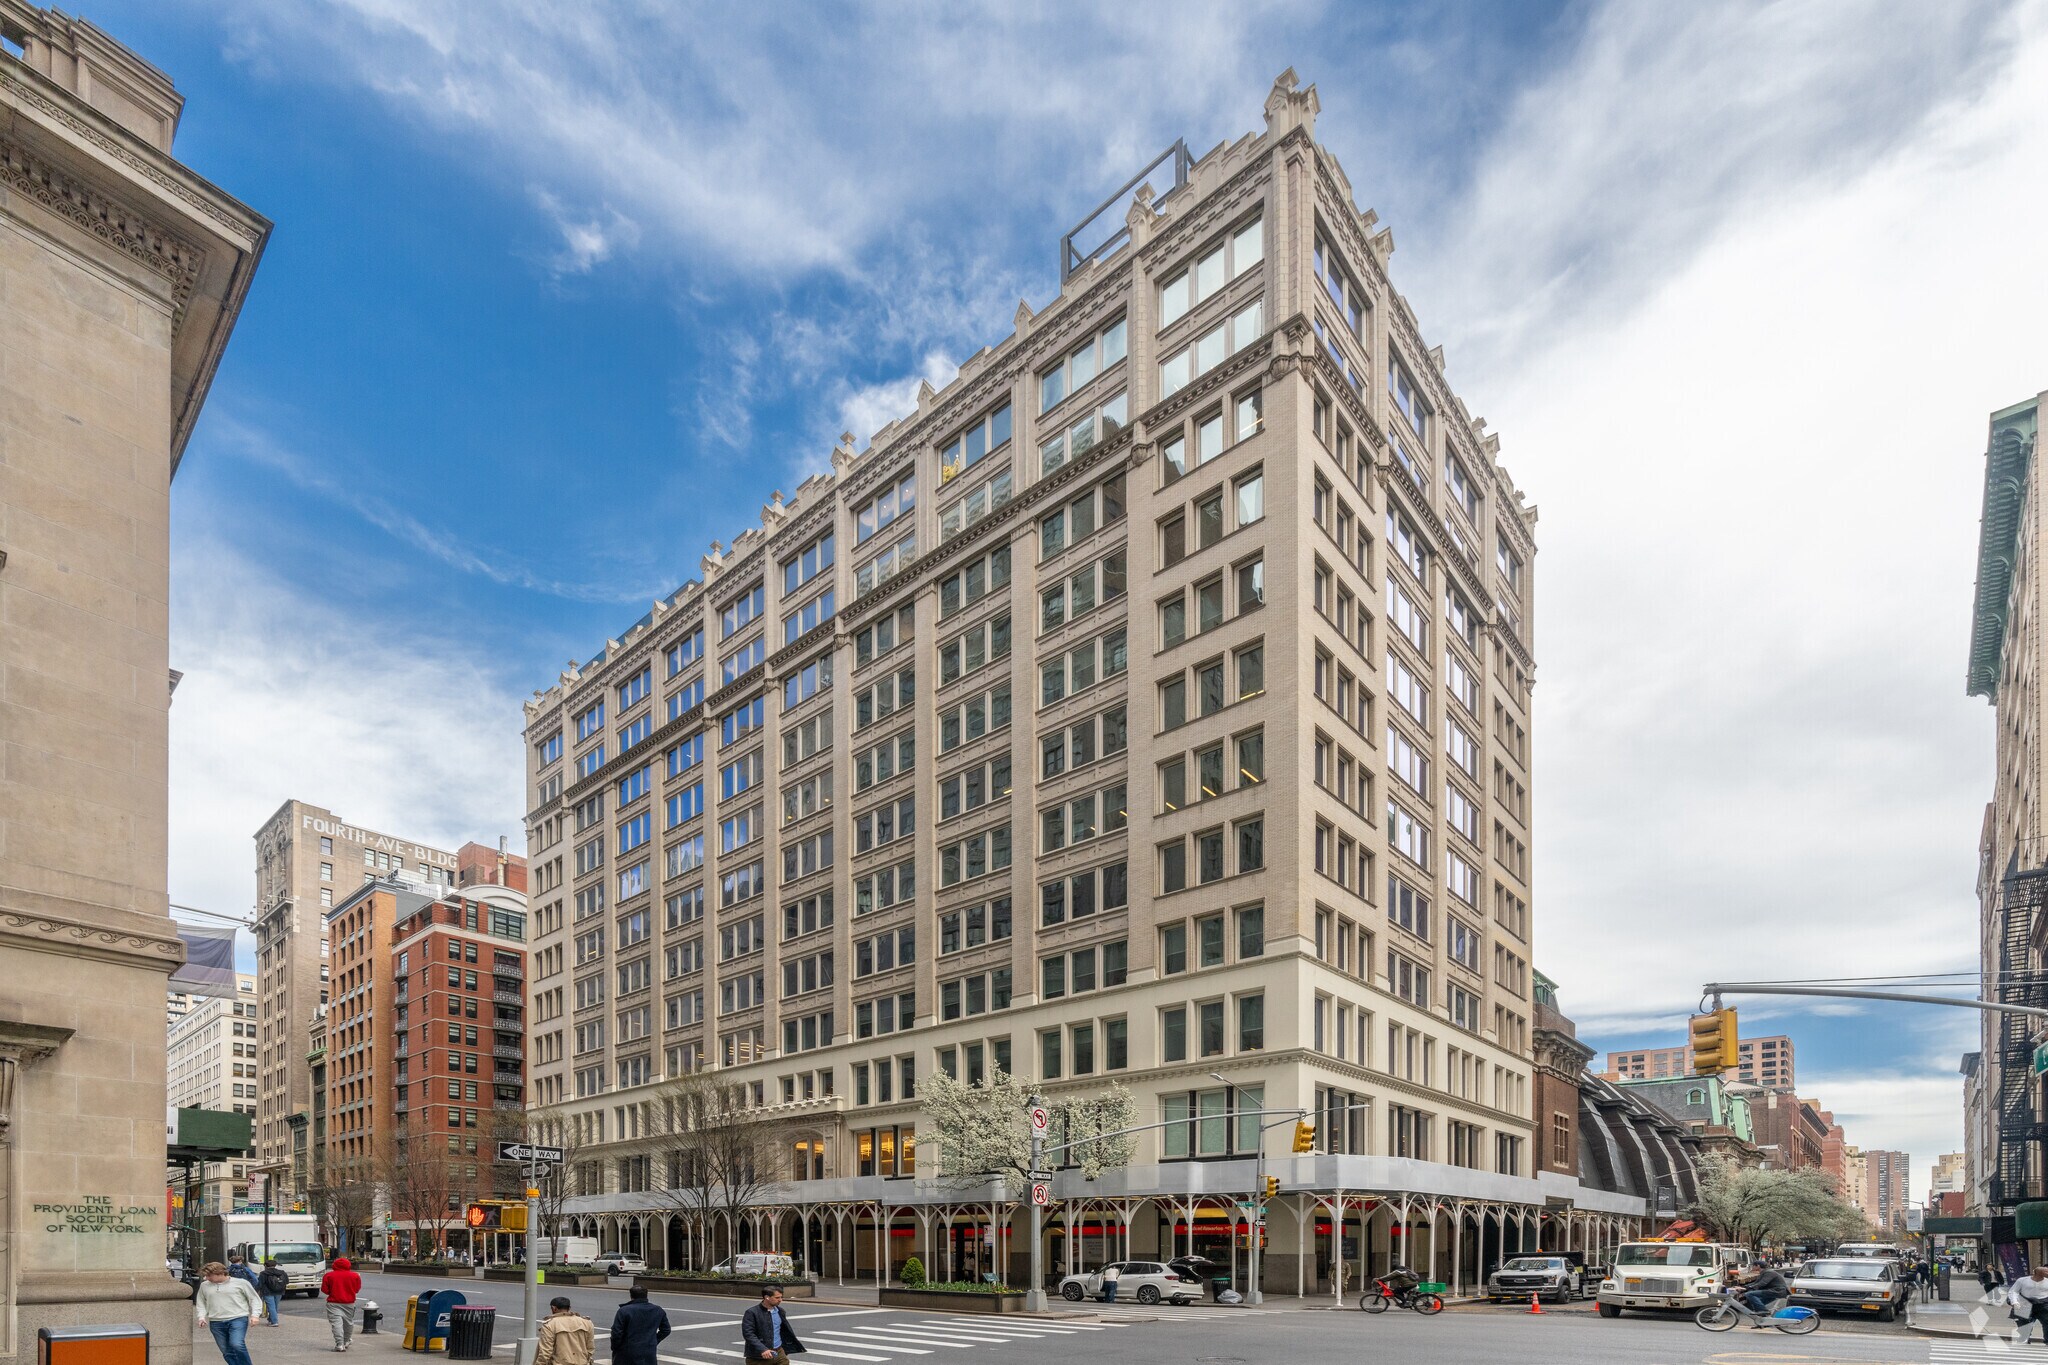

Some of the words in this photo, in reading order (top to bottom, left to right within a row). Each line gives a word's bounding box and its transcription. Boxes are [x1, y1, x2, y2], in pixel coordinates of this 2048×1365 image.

[303, 815, 366, 844] FOURTH
[375, 836, 406, 855] AVE
[414, 845, 458, 869] BLDG
[512, 1148, 530, 1157] ONE
[538, 1150, 557, 1159] WAY
[83, 1195, 112, 1204] THE
[33, 1204, 114, 1214] PROVIDENT
[120, 1206, 158, 1215] LOAN
[65, 1214, 127, 1224] SOCIETY
[46, 1224, 68, 1233] OF
[70, 1224, 104, 1233] NEW
[104, 1224, 145, 1234] YORK
